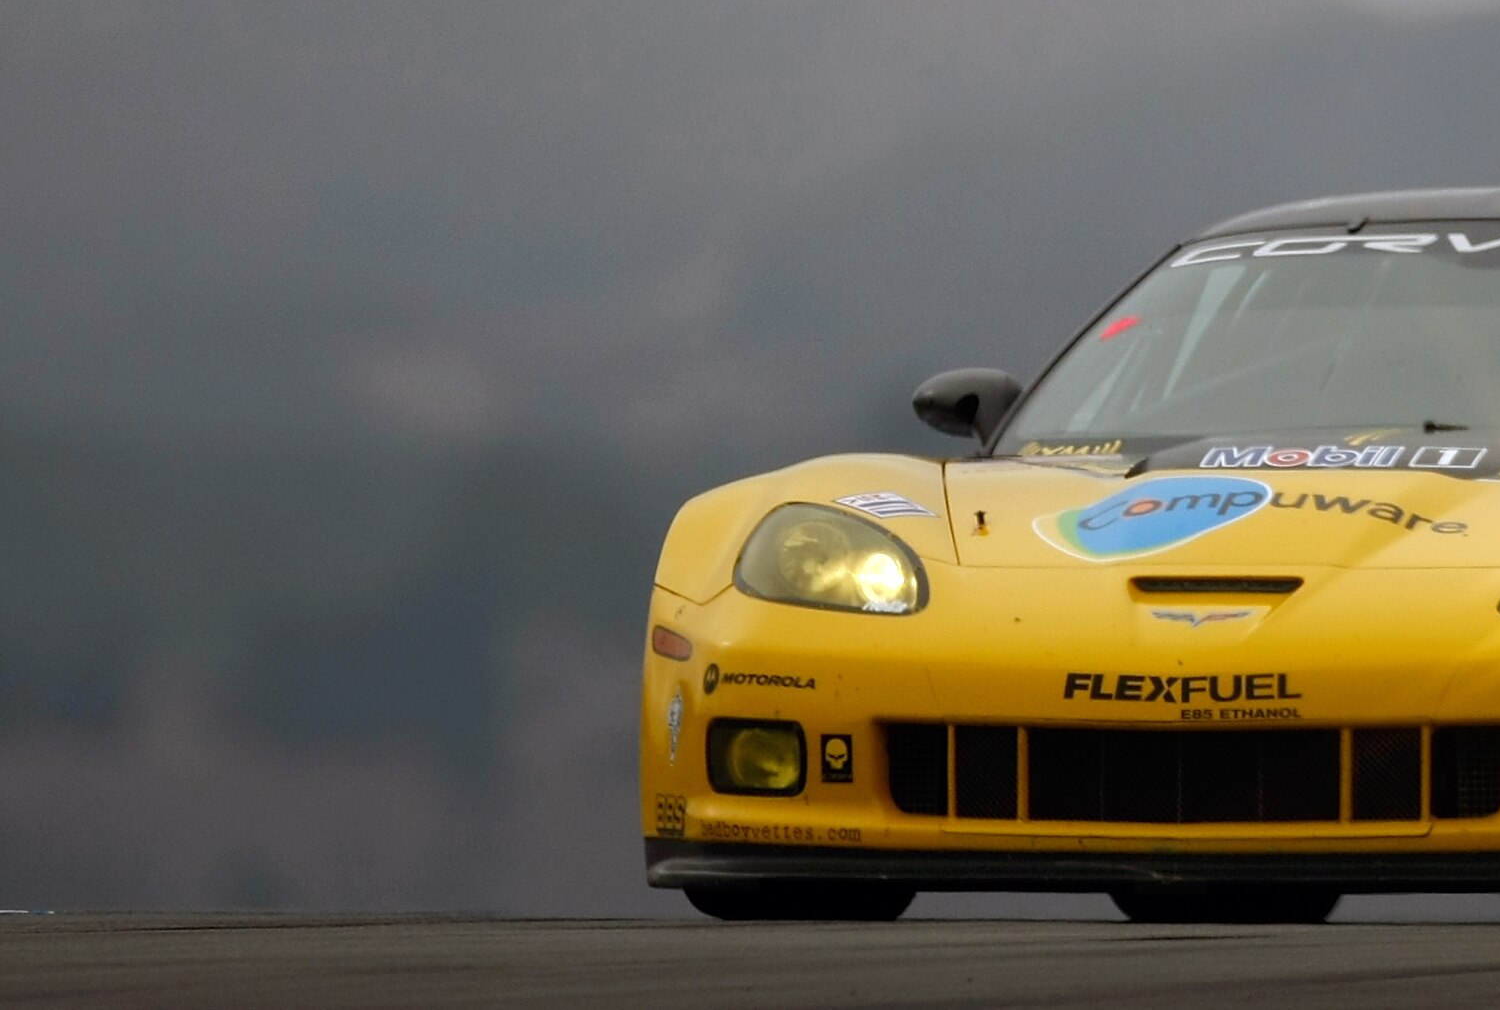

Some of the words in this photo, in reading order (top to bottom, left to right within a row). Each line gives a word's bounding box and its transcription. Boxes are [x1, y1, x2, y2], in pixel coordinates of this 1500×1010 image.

[1199, 445, 1405, 469] Mobil
[721, 672, 817, 690] MOTOROLA
[1063, 673, 1302, 704] FLEXFUEL
[1181, 709, 1213, 720] E85
[1220, 707, 1302, 719] ETHANOL
